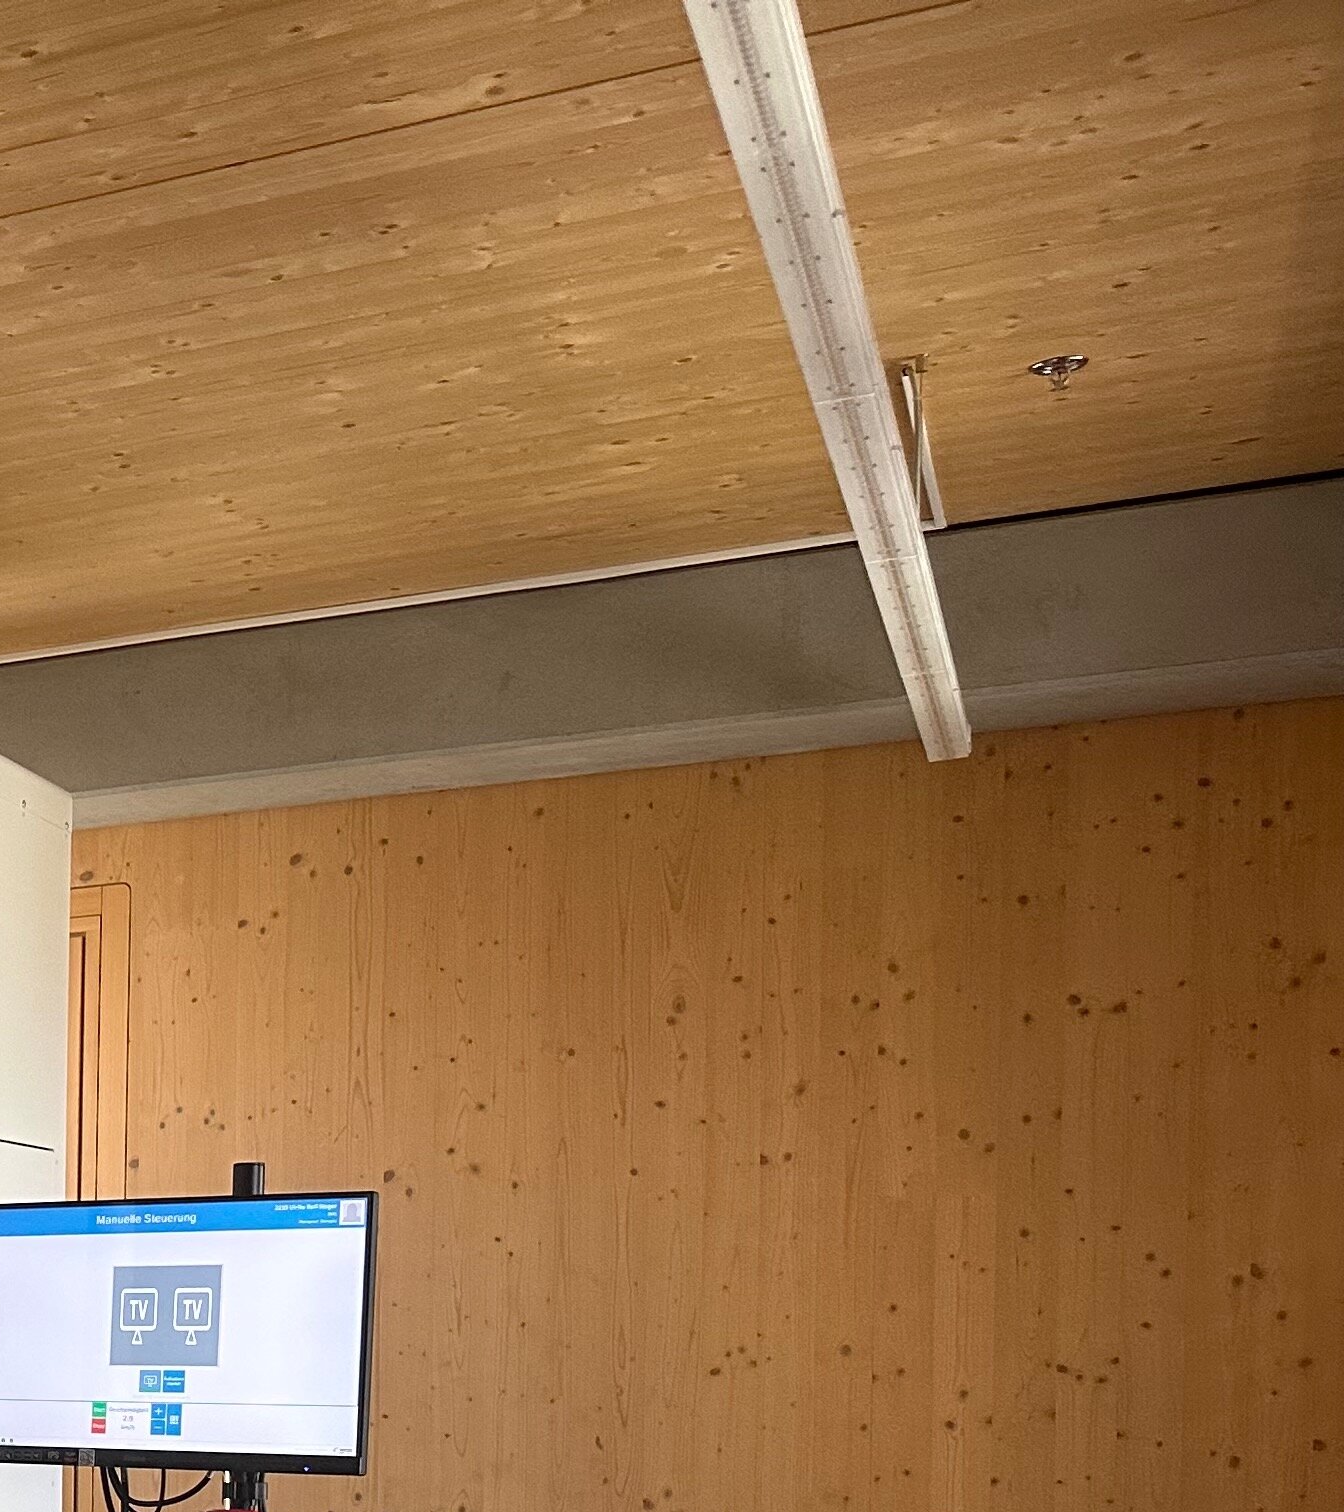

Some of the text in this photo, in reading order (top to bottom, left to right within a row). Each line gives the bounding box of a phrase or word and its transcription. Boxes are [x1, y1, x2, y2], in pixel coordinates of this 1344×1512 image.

[96, 1213, 197, 1225] Manuelle Steuerung
[129, 1299, 149, 1321] TV
[182, 1299, 203, 1321] TV
